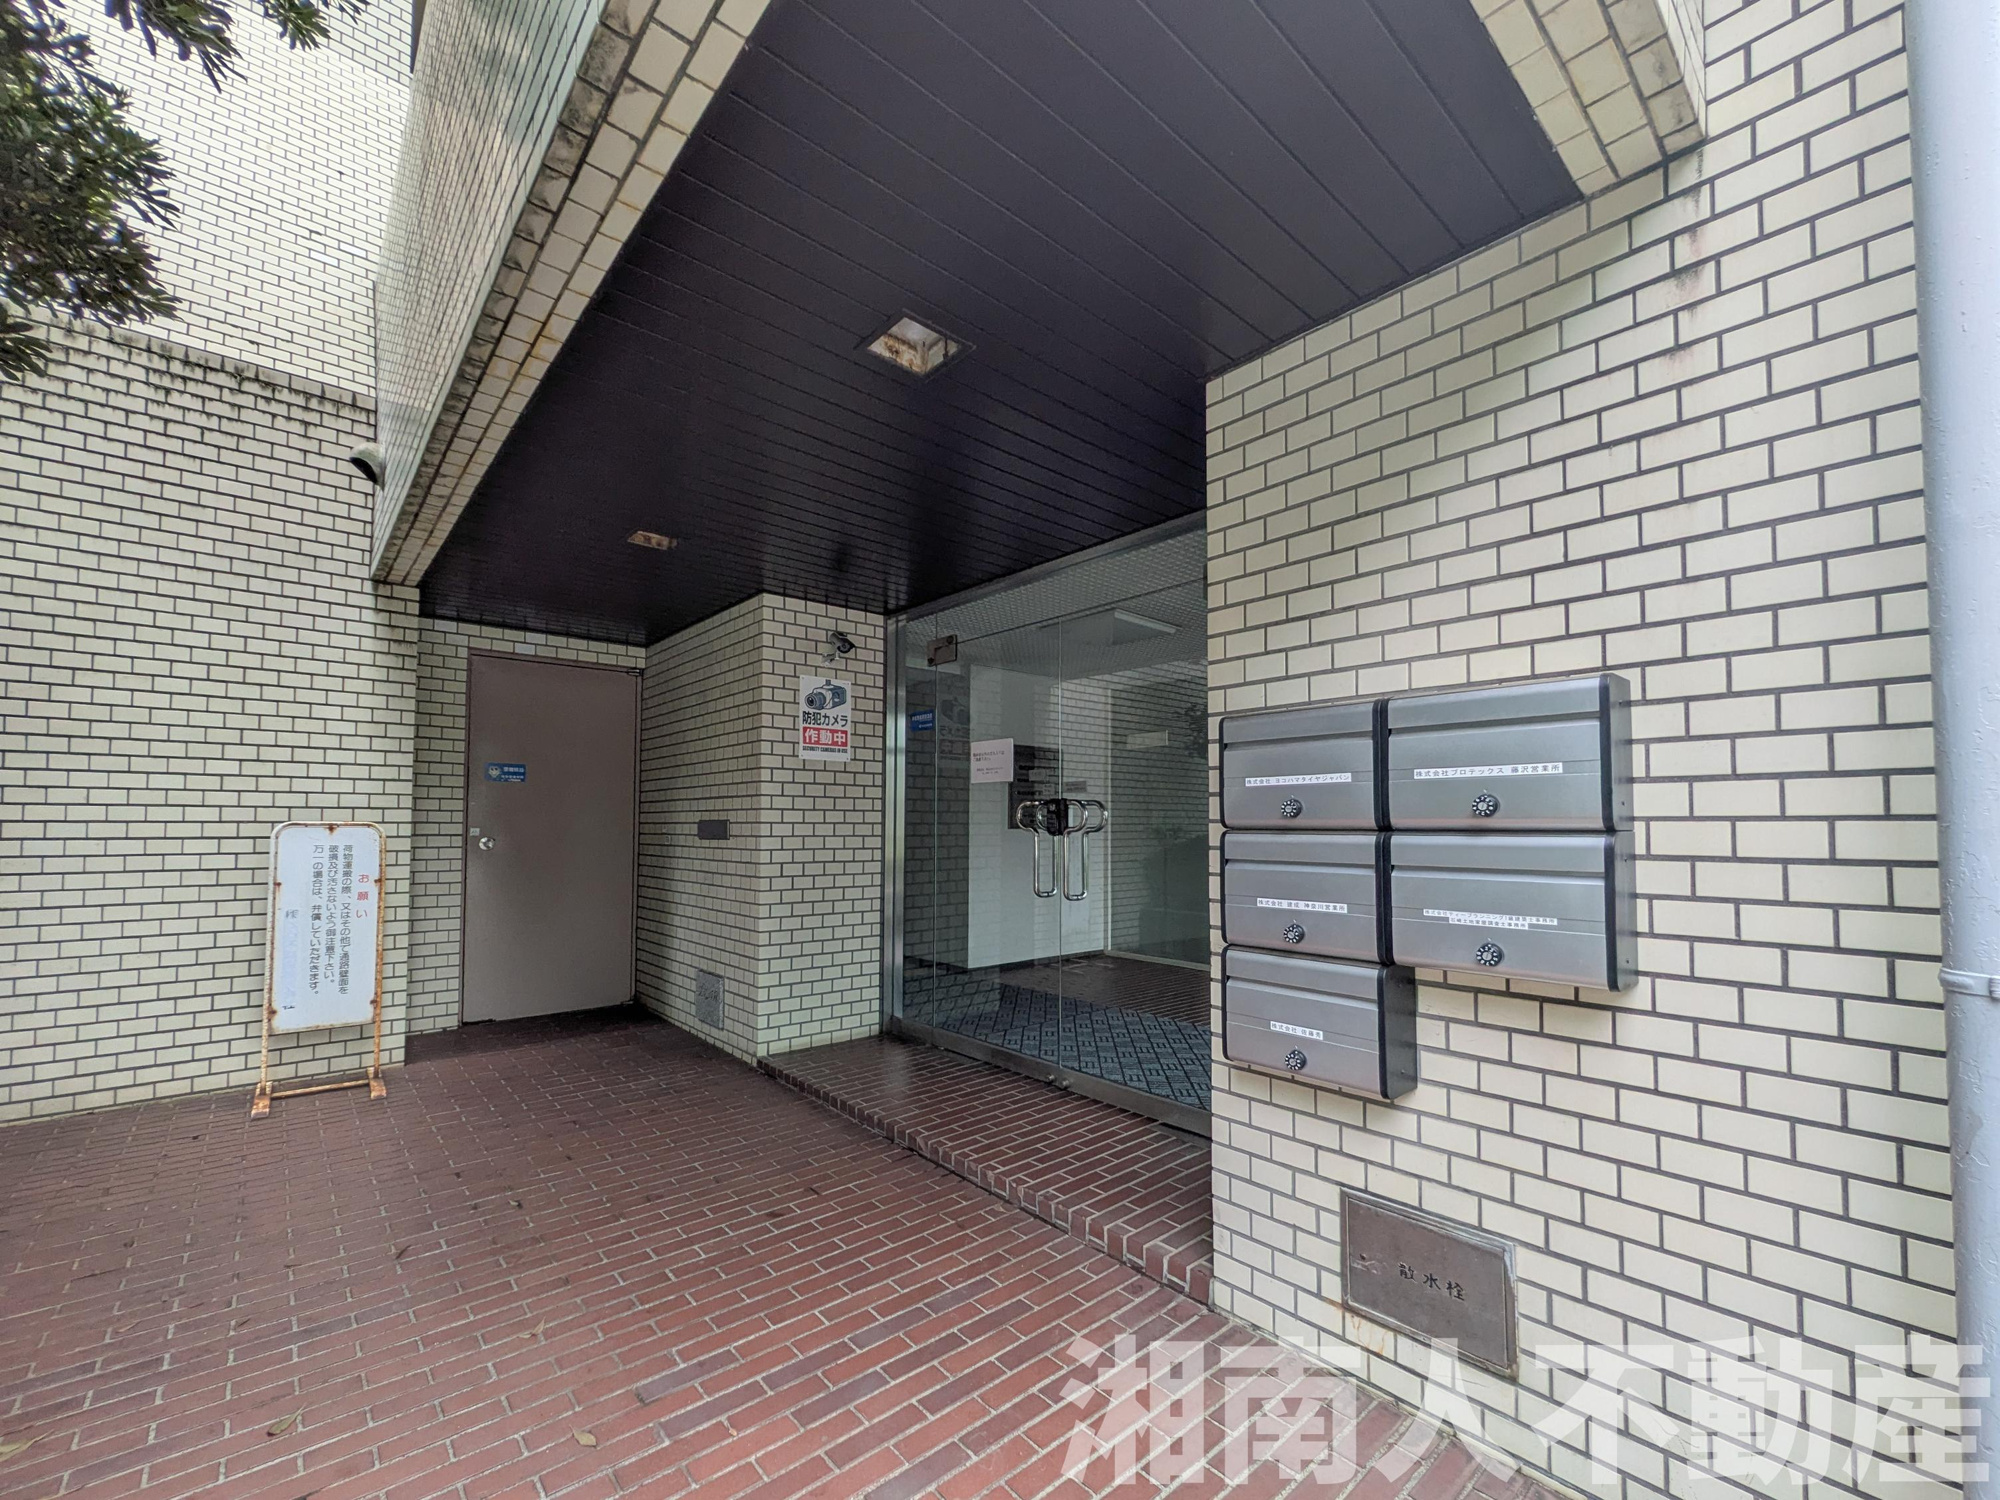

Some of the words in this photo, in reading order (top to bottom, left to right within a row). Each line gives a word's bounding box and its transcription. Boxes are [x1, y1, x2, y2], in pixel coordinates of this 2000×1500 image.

[803, 711, 848, 727] 防犯カメラ
[804, 728, 846, 745] 作動中
[1510, 764, 1560, 773] 藤沢営業所
[356, 873, 370, 918] お願い
[1399, 1263, 1465, 1302] 散水栓
